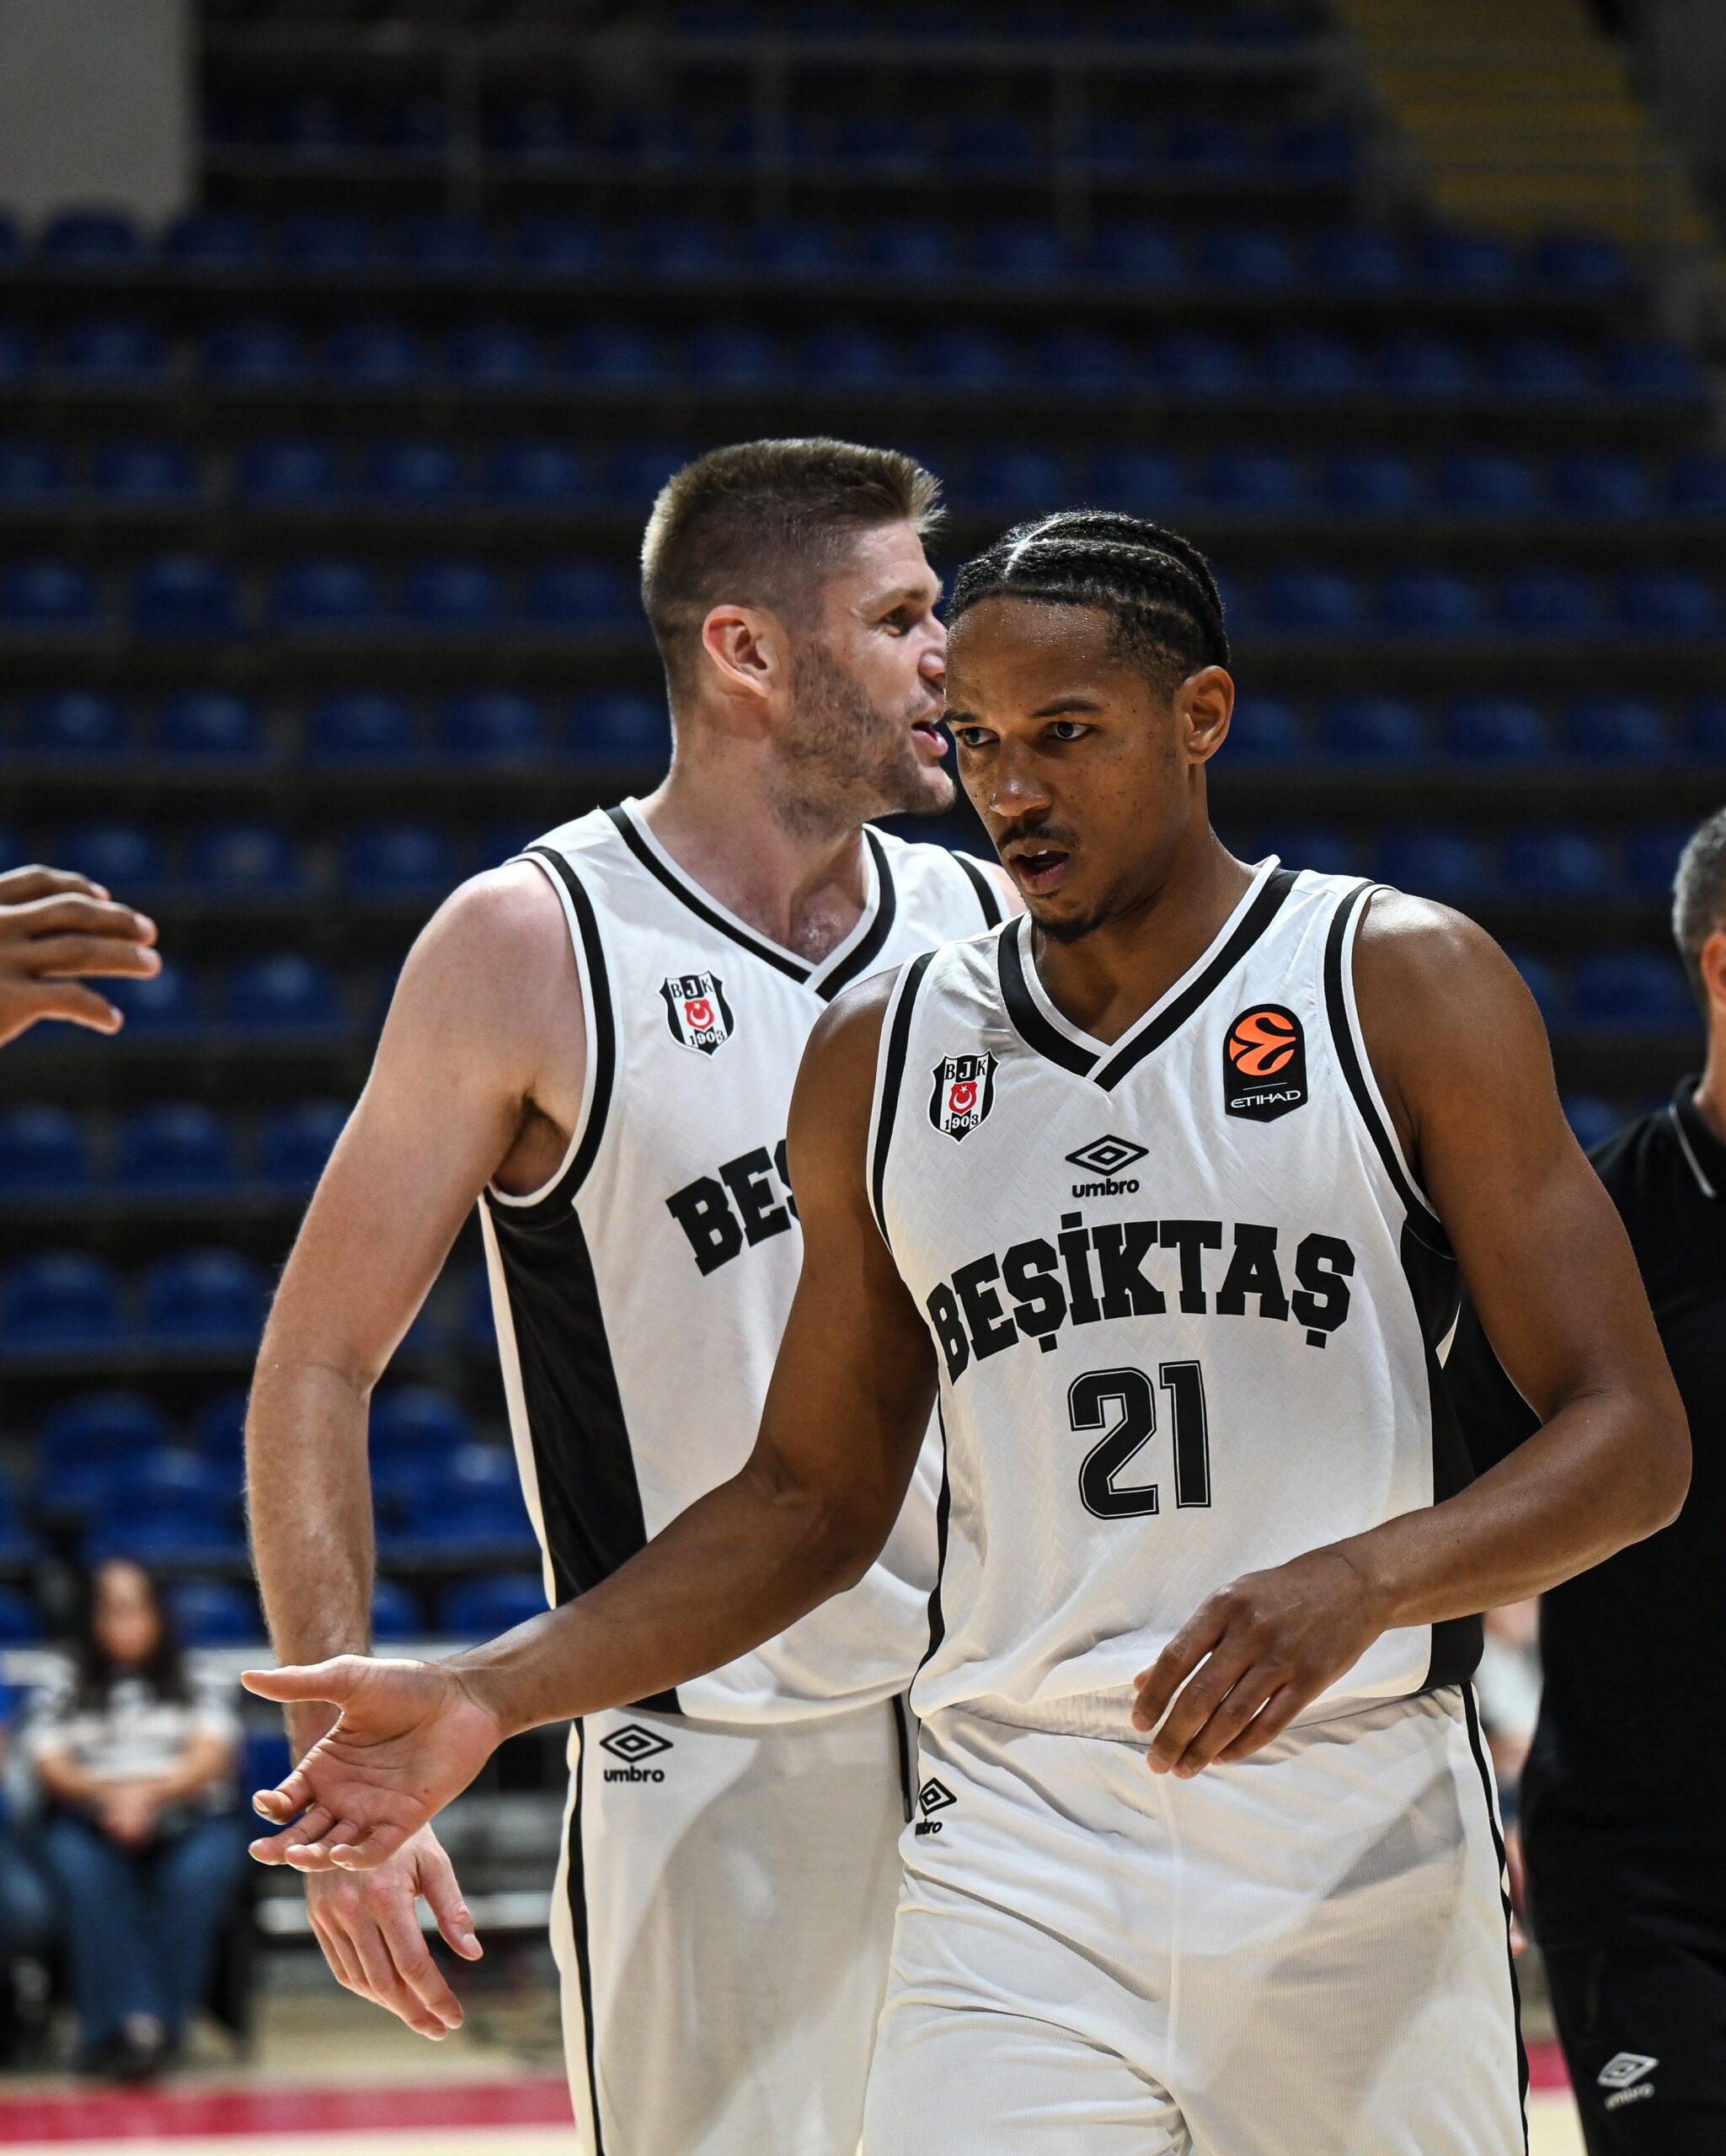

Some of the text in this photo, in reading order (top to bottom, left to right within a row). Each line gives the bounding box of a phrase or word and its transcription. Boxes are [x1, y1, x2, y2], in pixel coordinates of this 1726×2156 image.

[671, 978, 713, 998] BJK
[688, 1030, 725, 1046] 1903
[944, 1059, 987, 1080] BJK
[1231, 1090, 1301, 1108] ETIHAD
[944, 1113, 979, 1130] 1903
[1071, 1177, 1140, 1198] umbro
[926, 1211, 1356, 1386] BEŞİKTAŞ
[1067, 1359, 1211, 1521] 21
[604, 1765, 665, 1783] umbro
